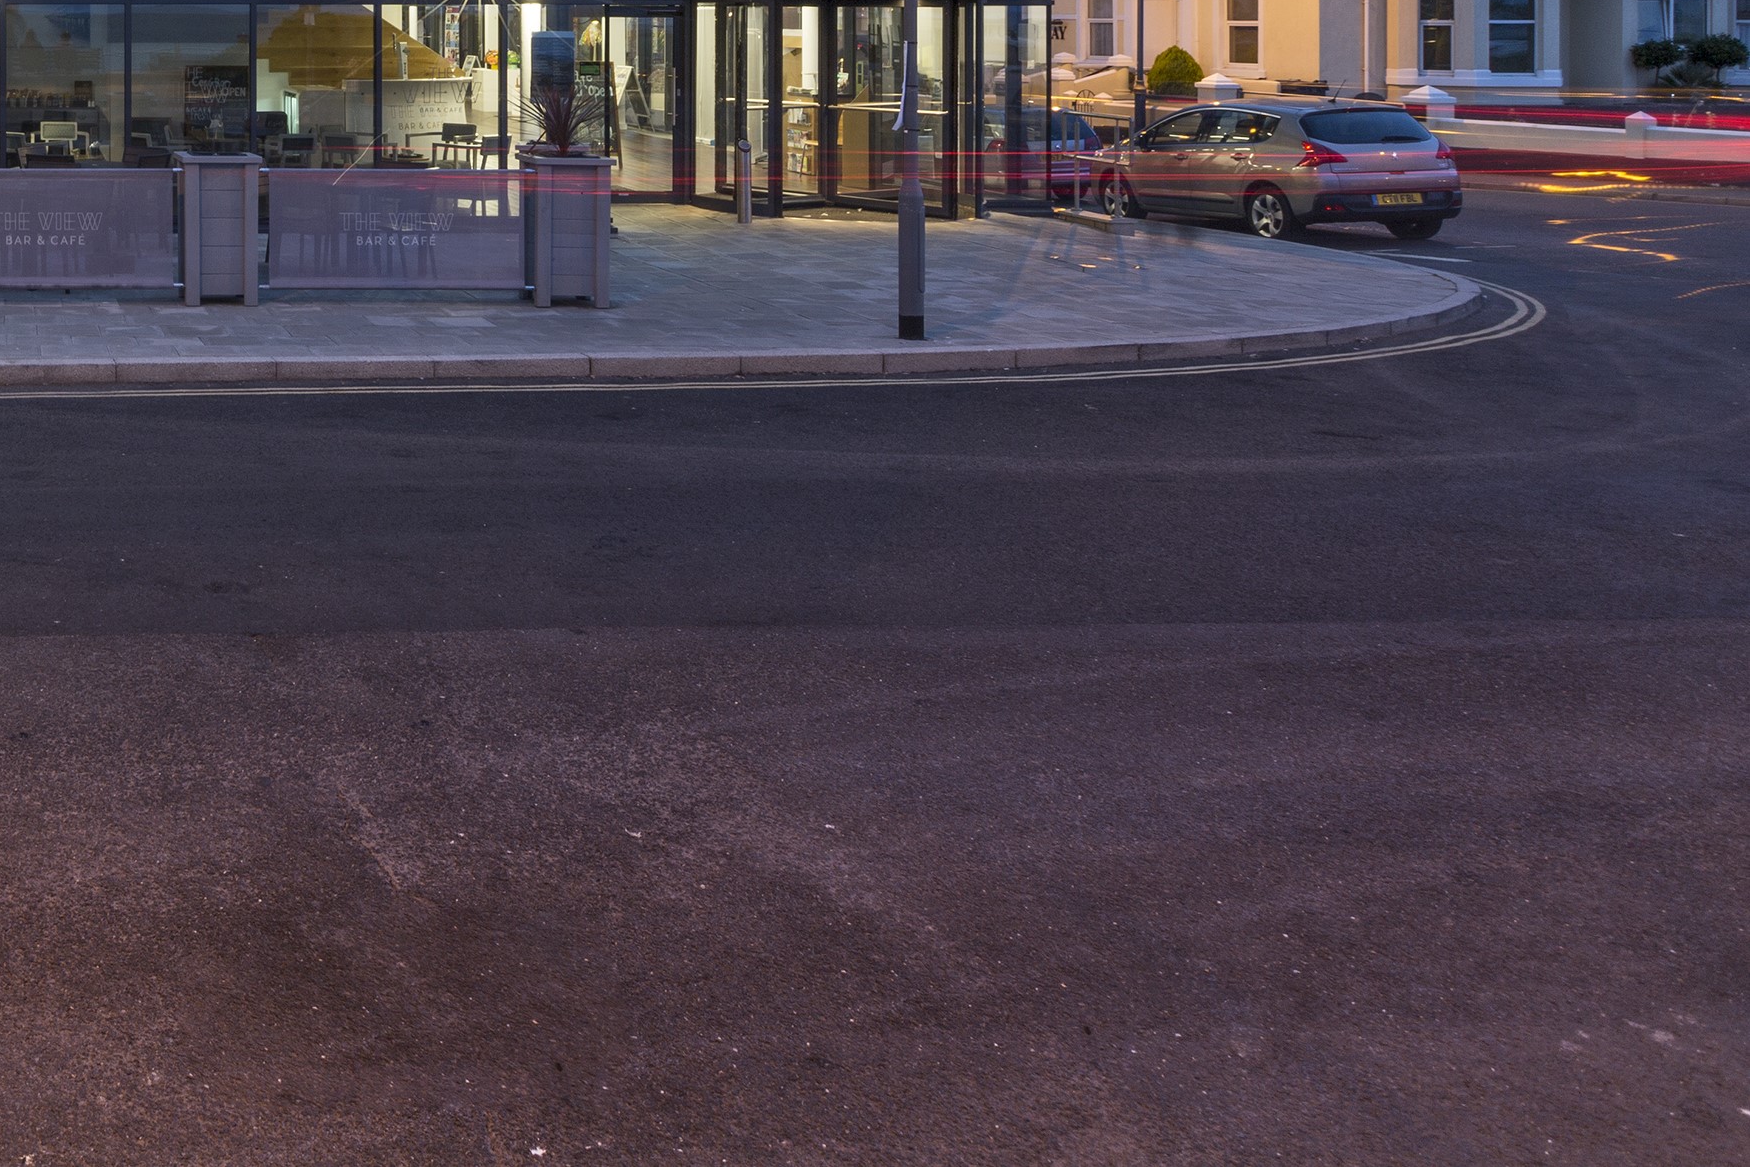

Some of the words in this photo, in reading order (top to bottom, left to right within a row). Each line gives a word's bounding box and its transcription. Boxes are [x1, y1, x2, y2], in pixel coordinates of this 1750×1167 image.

[402, 81, 482, 104] VIEW
[399, 122, 416, 130] BAR
[419, 122, 424, 130] &
[427, 121, 443, 130] CAF
[38, 212, 103, 231] VIEW
[338, 212, 381, 232] THE
[388, 212, 454, 232] VIEW
[6, 235, 31, 246] BAR
[37, 235, 46, 246] &
[50, 233, 86, 246] CAFÉ
[356, 236, 382, 246] BAR
[388, 236, 396, 246] &
[402, 233, 436, 246] CAFÉ
